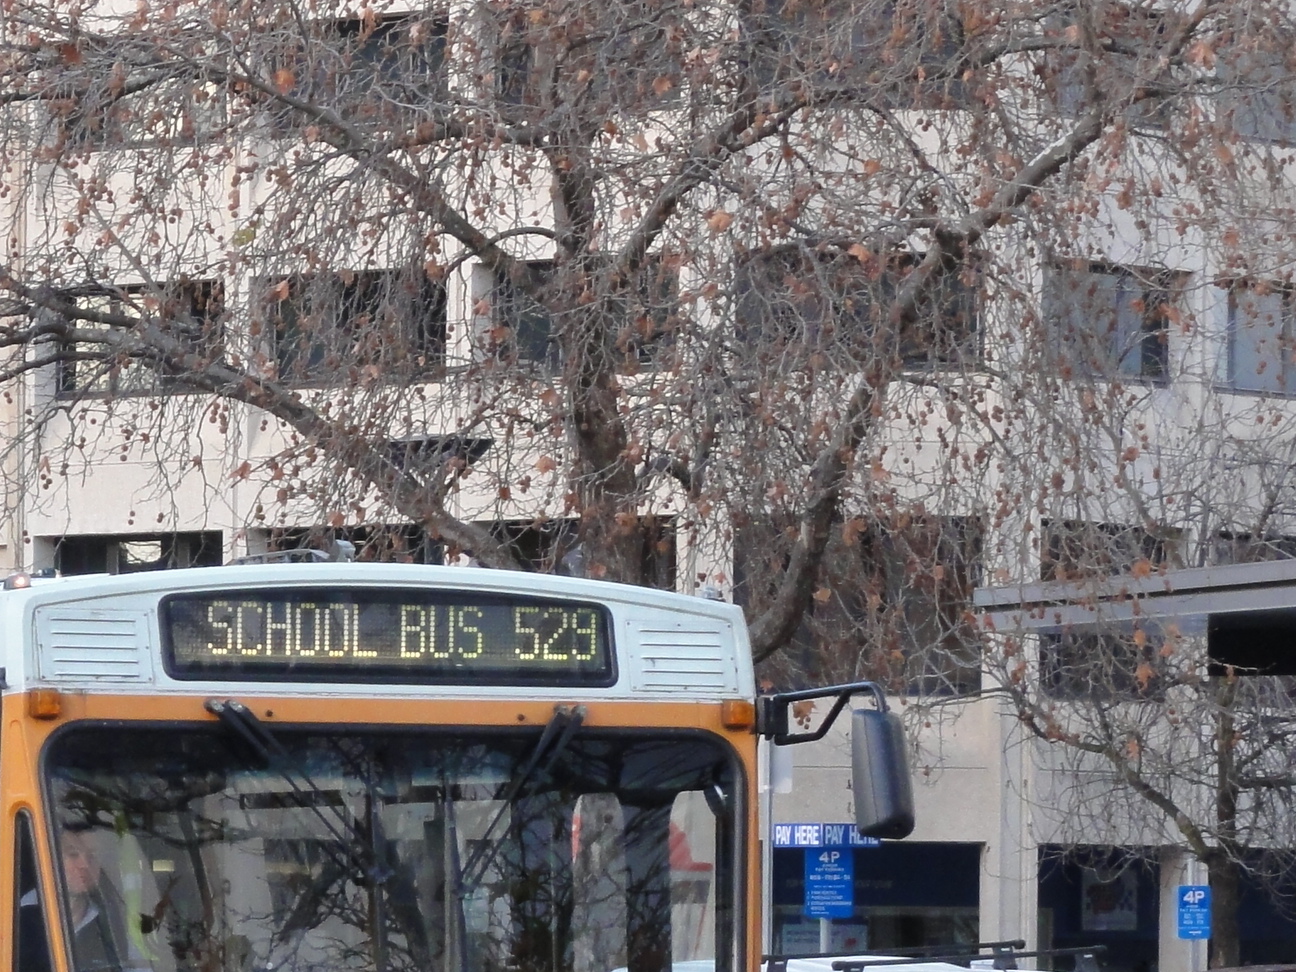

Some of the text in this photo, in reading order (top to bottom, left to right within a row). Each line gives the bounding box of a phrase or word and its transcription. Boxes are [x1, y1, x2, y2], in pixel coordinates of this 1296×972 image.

[207, 601, 597, 661] SCHOOL BUS 529
[775, 825, 820, 845] PAY HERE
[825, 825, 845, 845] PAY
[818, 851, 841, 863] 4P
[1183, 890, 1205, 904] 4P
